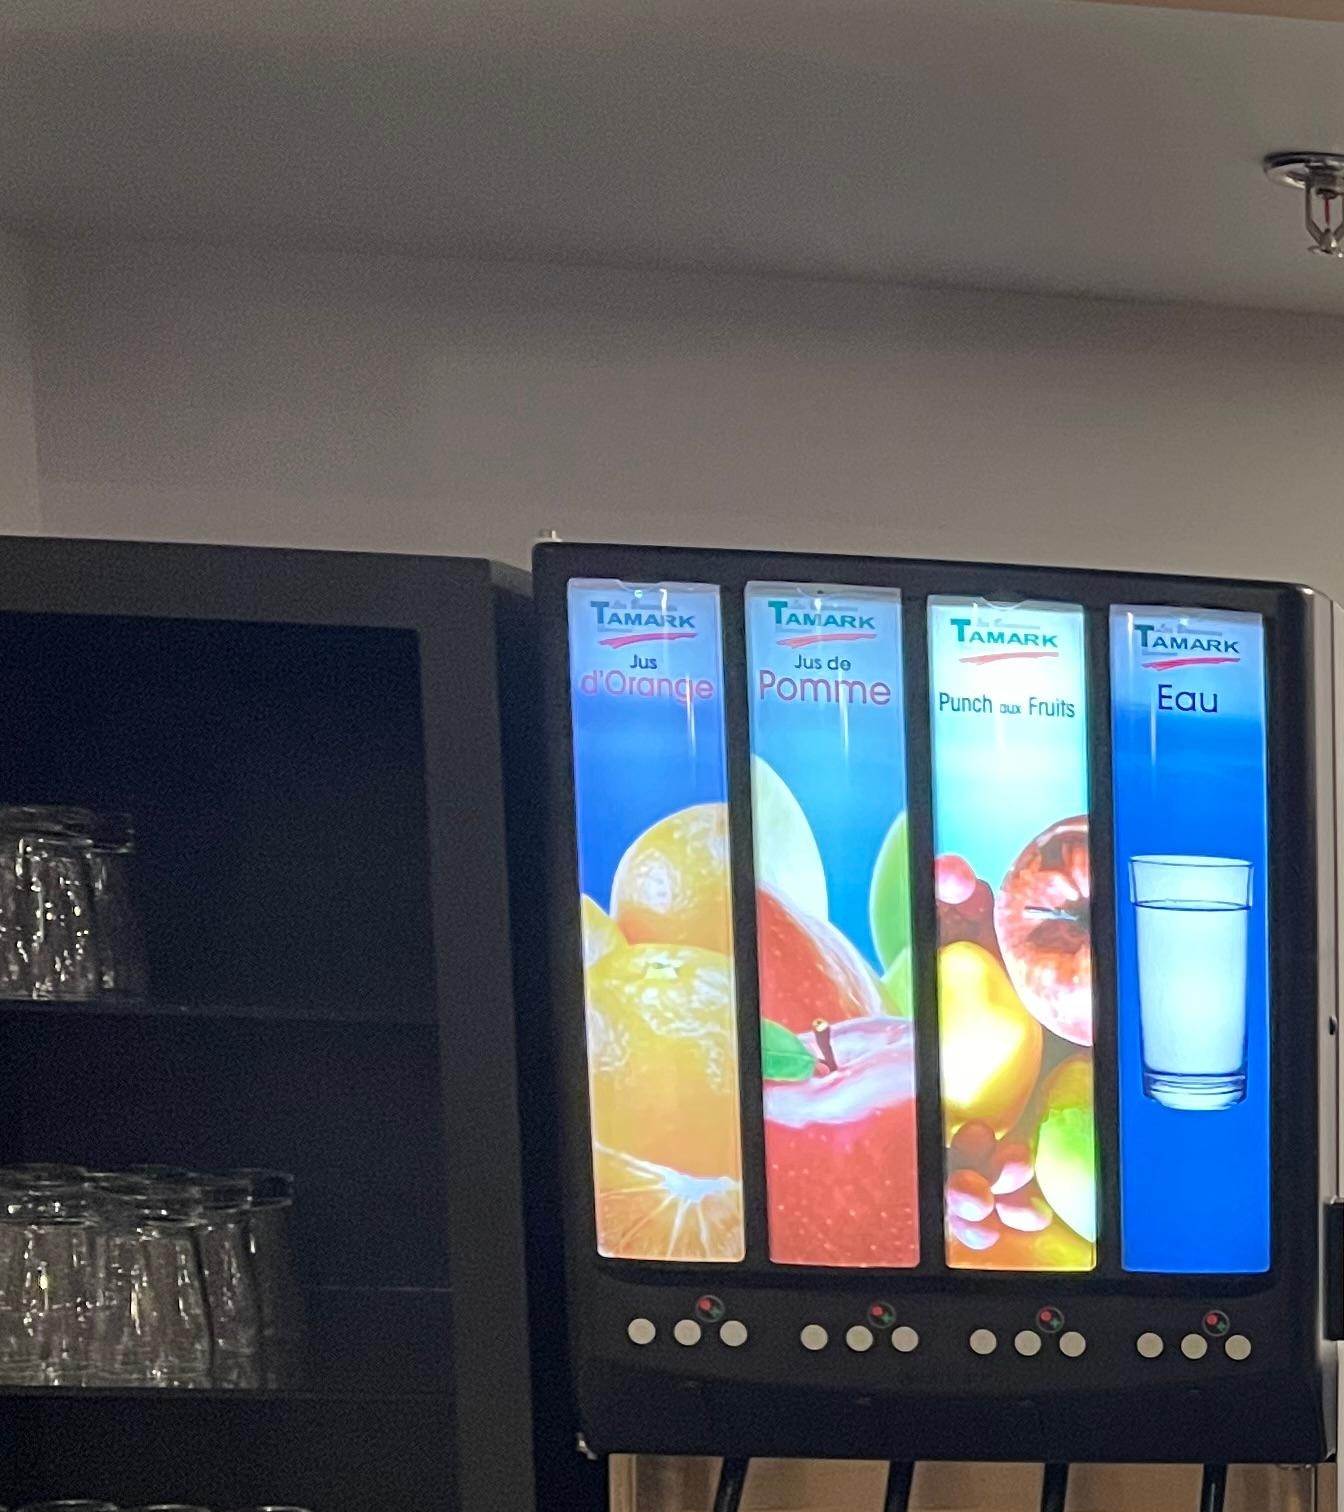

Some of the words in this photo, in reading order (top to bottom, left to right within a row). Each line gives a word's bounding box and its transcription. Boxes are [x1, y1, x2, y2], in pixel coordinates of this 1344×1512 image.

[590, 601, 695, 628] TAMARK
[768, 601, 875, 629] TAMARK
[950, 618, 1057, 648] TAMARK
[1134, 624, 1239, 653] TAMARK
[630, 654, 657, 669] Jus
[795, 654, 822, 669] Jus
[827, 656, 851, 671] de
[580, 669, 714, 704] d'Orange
[759, 669, 891, 705] Pomme
[1158, 683, 1217, 713] Eau
[939, 692, 992, 713] Punch
[1000, 703, 1021, 714] aux
[1029, 696, 1075, 718] Fruits
